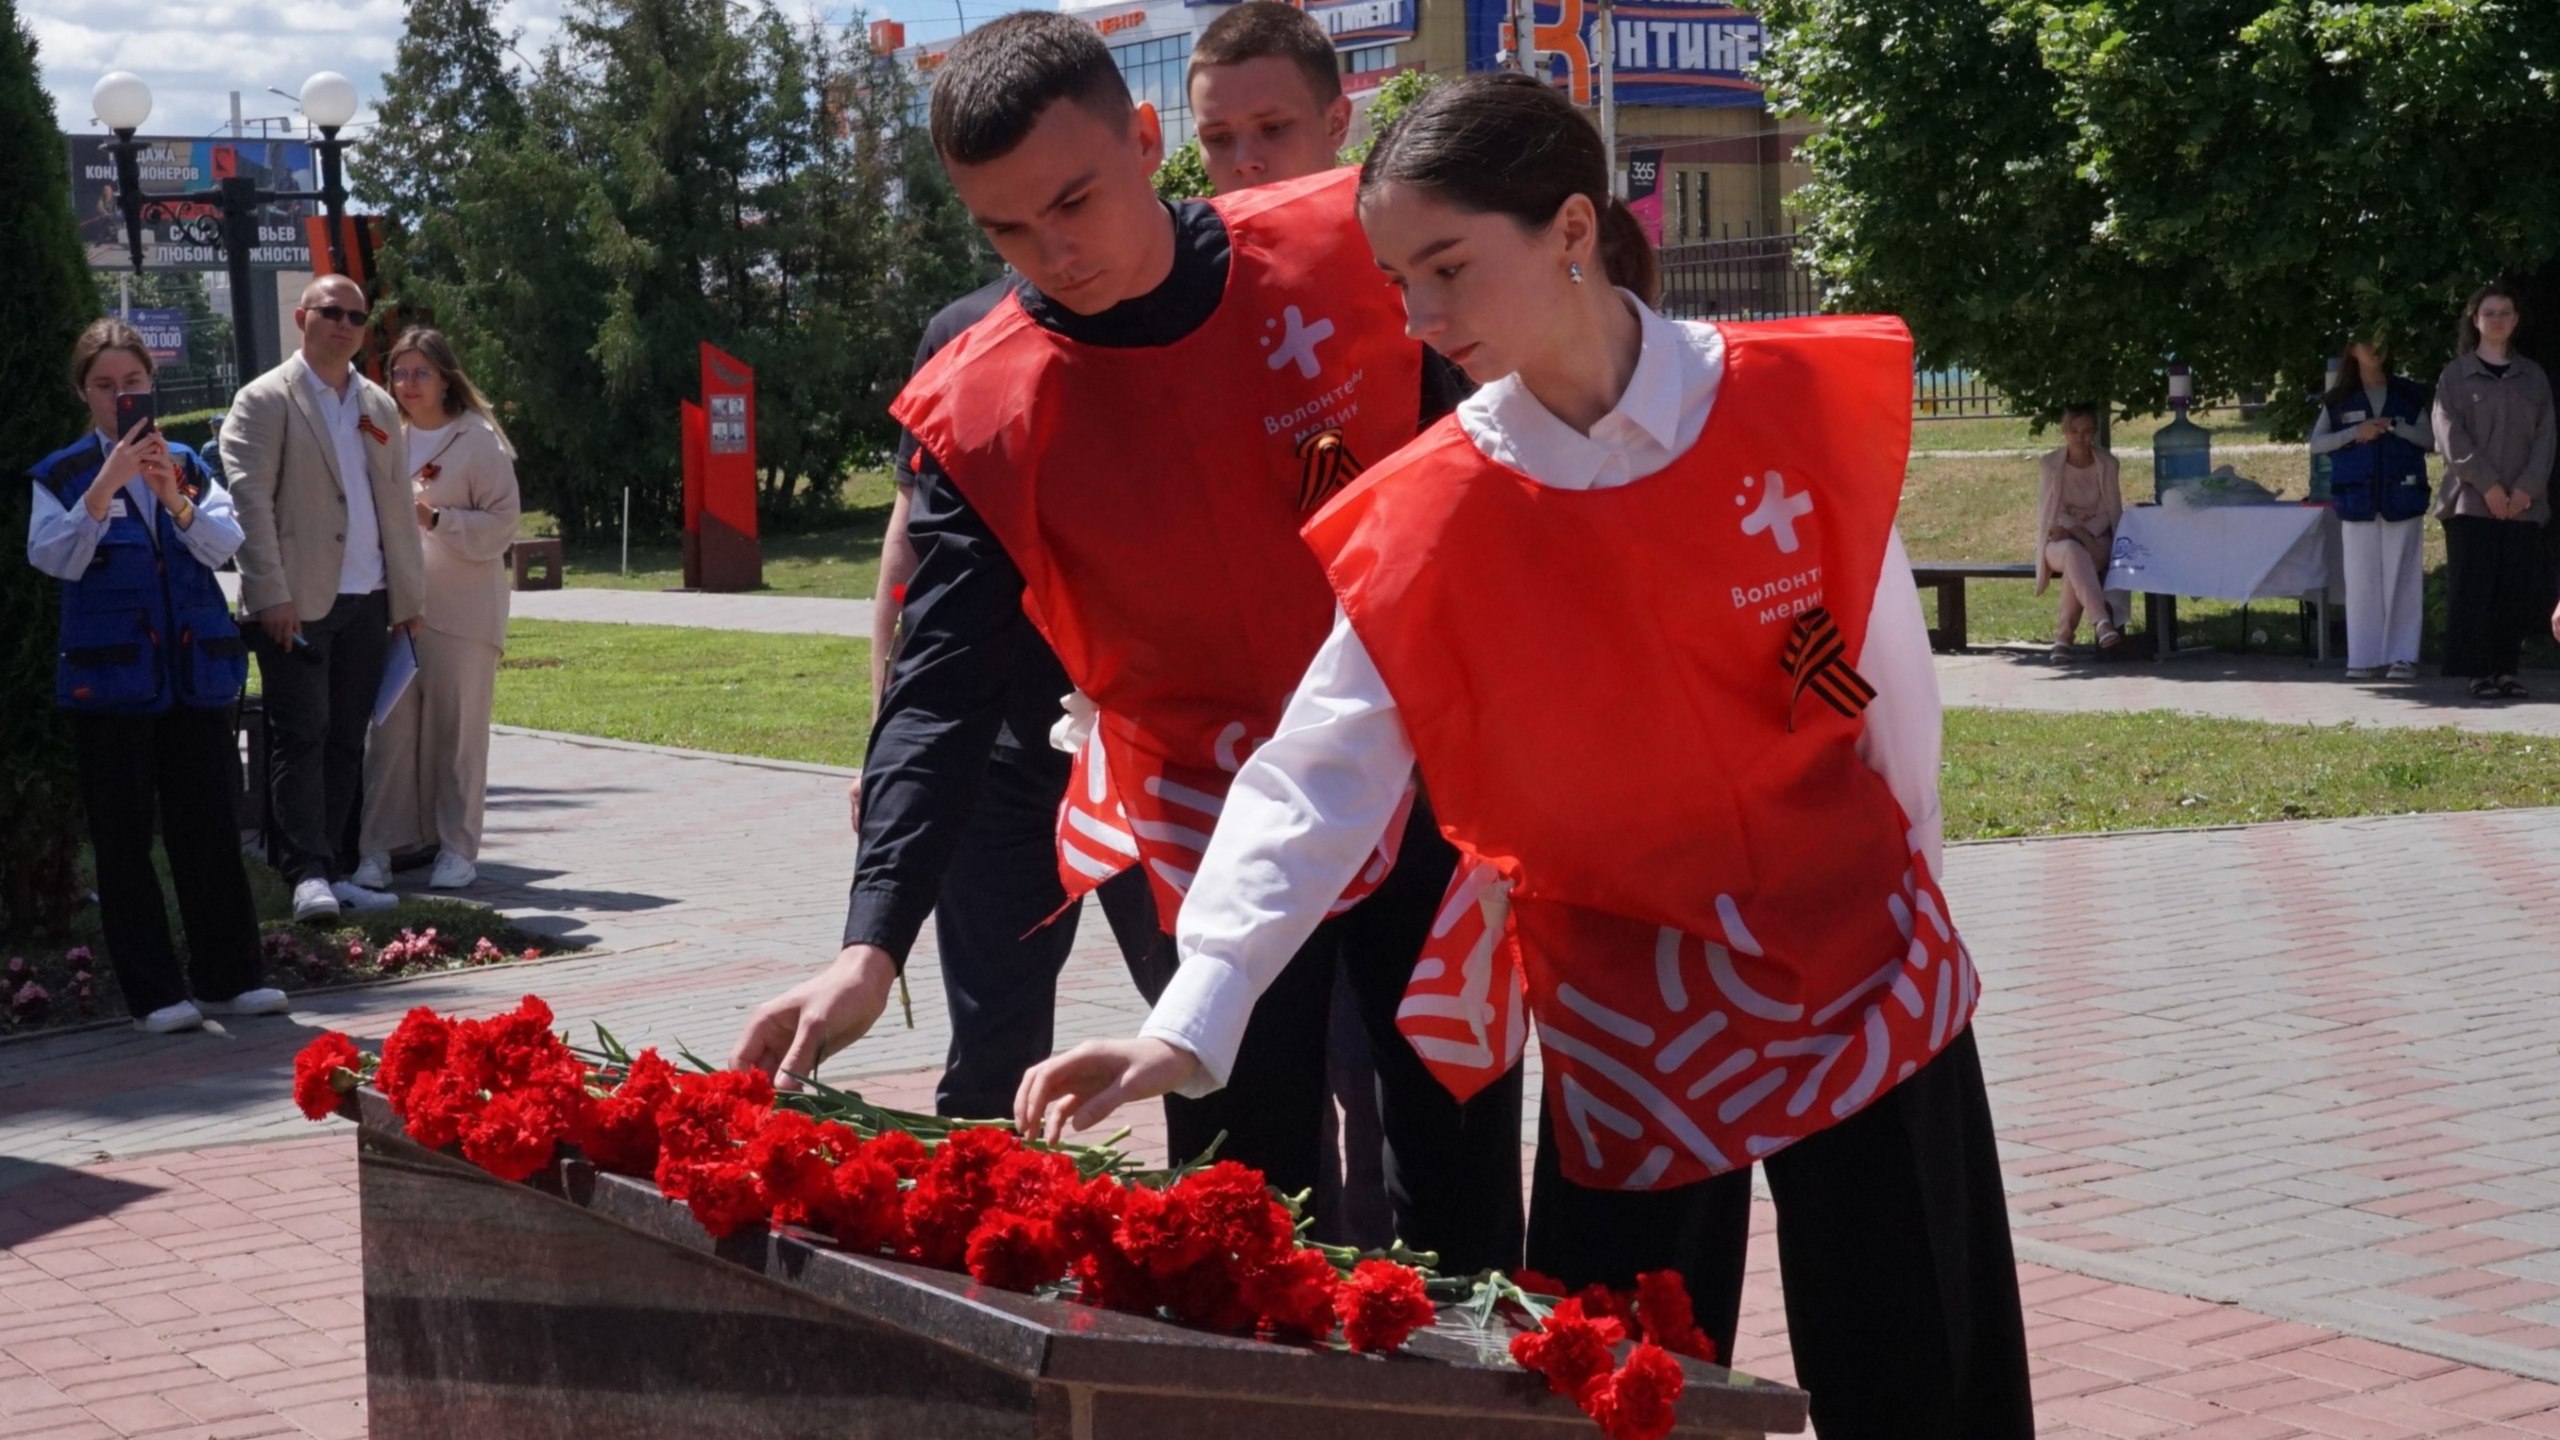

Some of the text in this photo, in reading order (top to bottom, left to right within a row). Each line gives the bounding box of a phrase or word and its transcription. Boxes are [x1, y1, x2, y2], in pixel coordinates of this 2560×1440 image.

[85, 165, 199, 181] КОНДИОНЕРОВ
[1631, 162, 1656, 179] 365
[217, 247, 310, 262] СЖНОСТИ
[1730, 565, 1822, 610] Волонт
